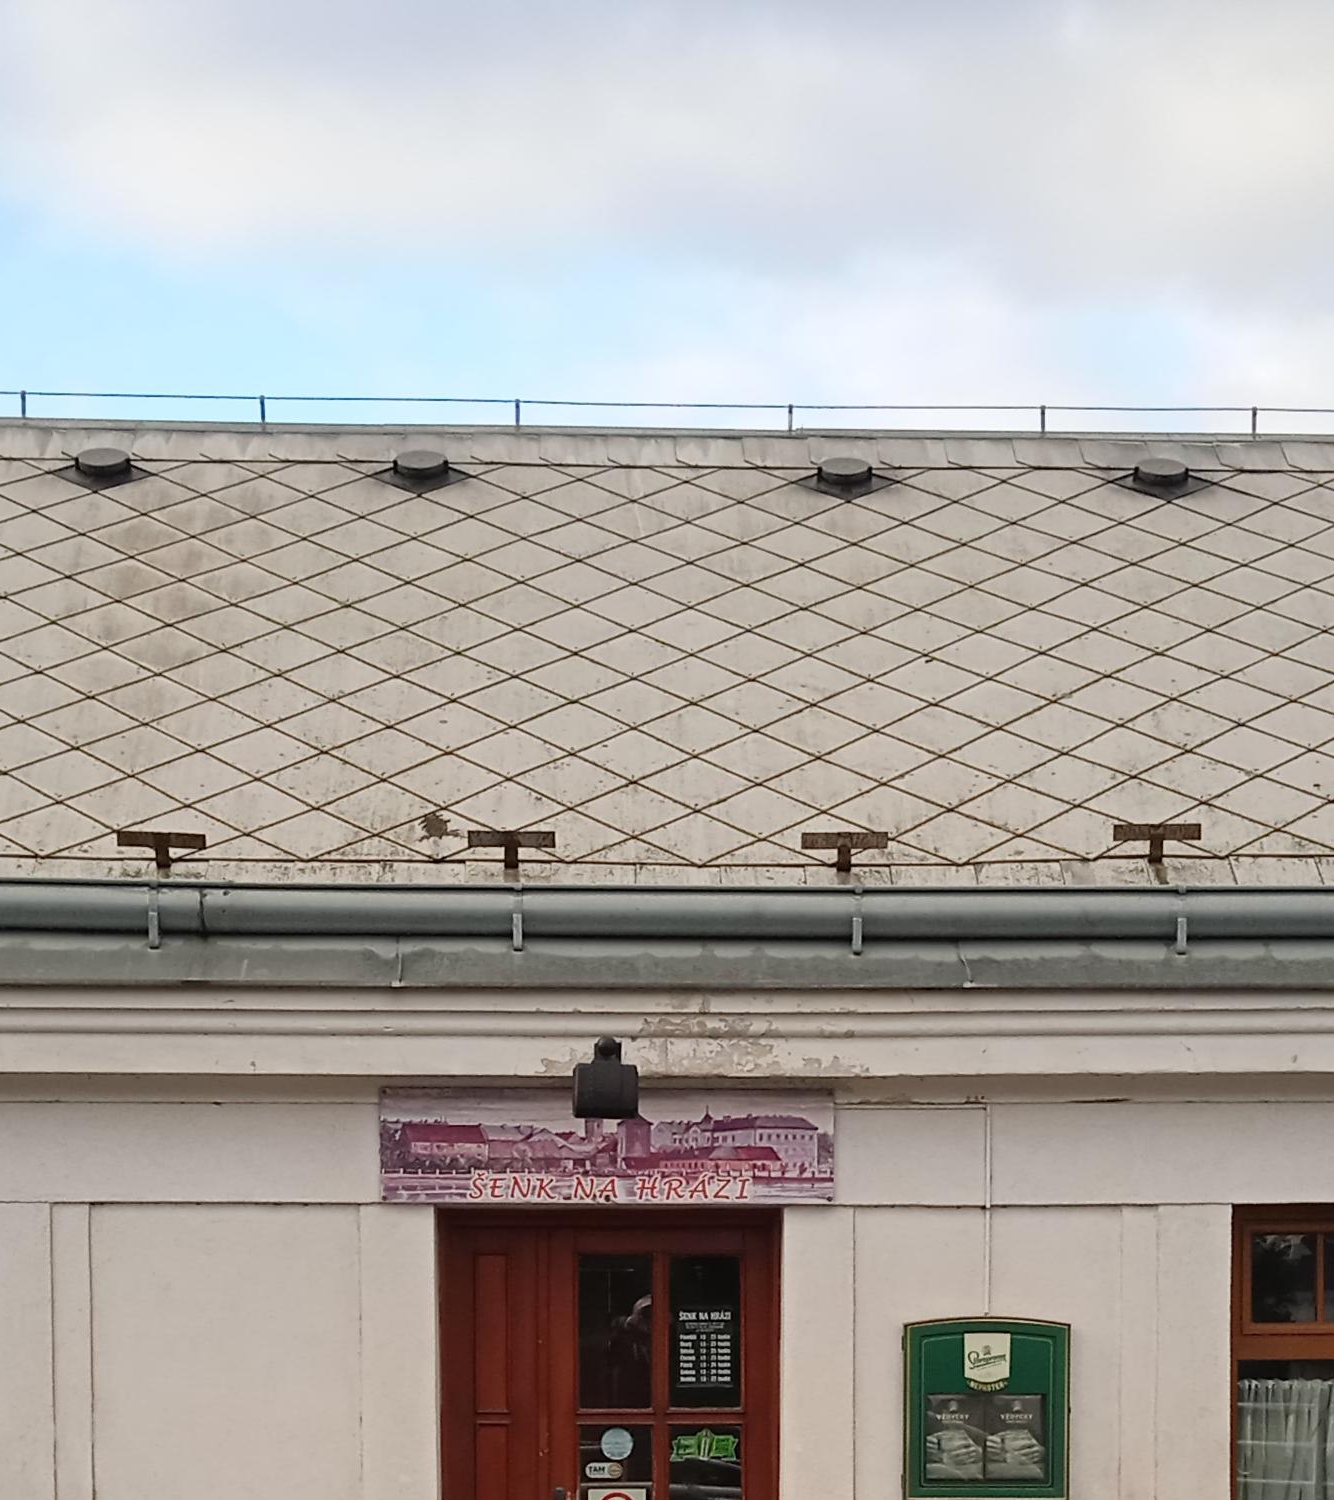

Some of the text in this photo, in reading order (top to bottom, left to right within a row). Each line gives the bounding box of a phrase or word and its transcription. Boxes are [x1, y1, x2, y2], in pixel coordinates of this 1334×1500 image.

[470, 1172, 752, 1200] ŠENK NA HRÁZI
